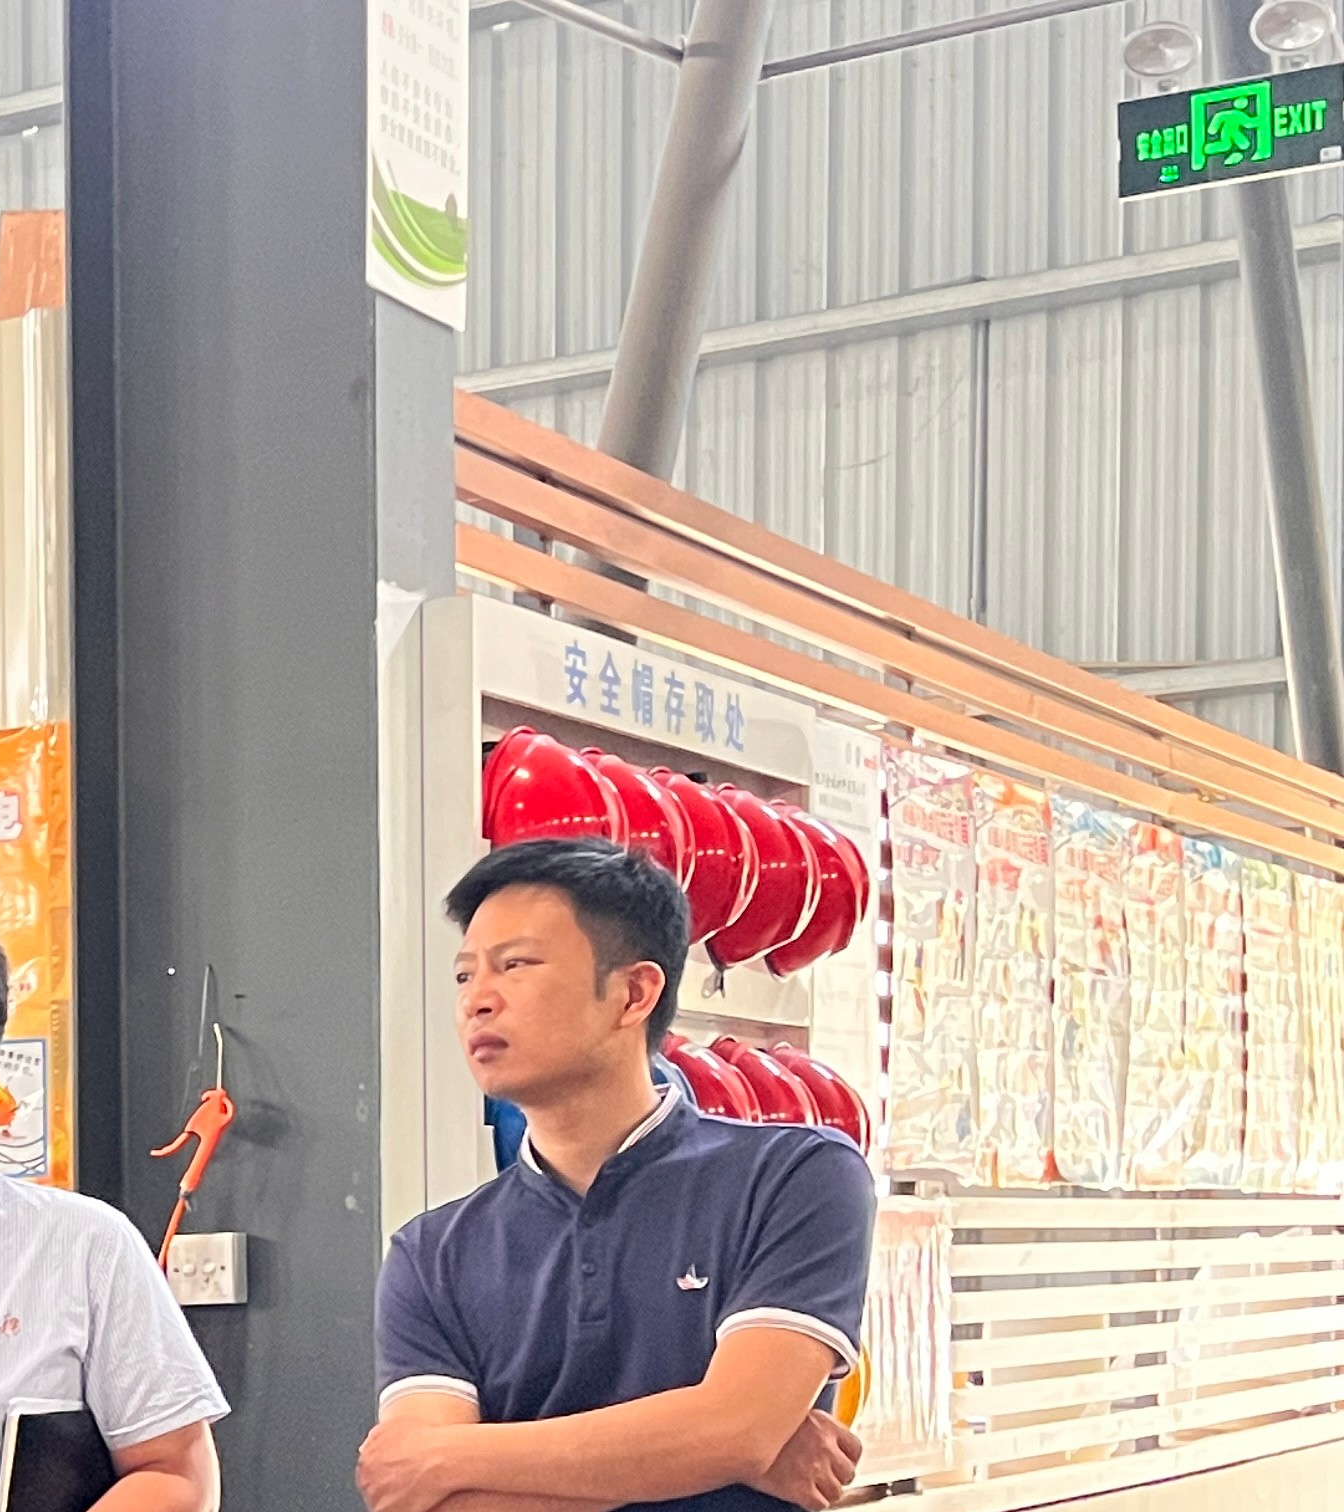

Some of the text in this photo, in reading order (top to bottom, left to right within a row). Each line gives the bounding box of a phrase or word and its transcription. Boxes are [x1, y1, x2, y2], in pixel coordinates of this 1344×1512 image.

[1274, 100, 1327, 138] EXIT
[564, 639, 745, 752] 安全帽存取处
